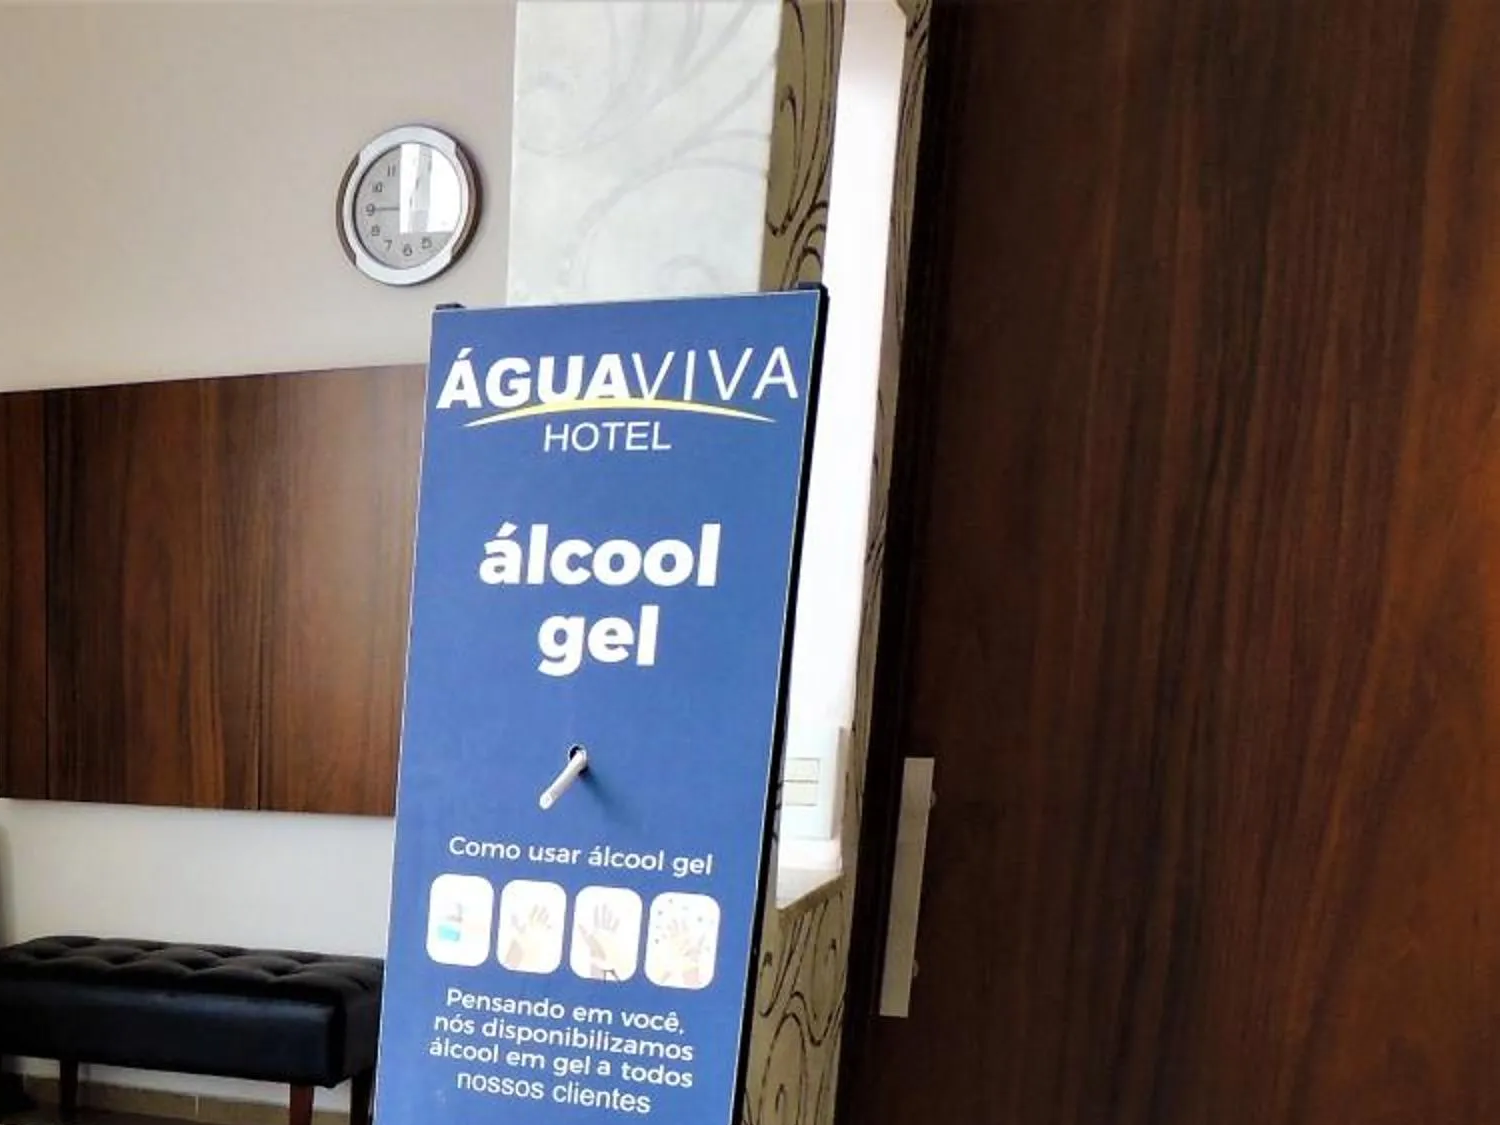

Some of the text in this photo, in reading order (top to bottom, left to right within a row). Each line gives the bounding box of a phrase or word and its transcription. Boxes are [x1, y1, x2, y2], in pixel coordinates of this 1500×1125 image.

[435, 346, 799, 410] ÁGUAVIVA
[543, 421, 672, 453] HOTEL
[479, 522, 721, 587] álcool
[536, 605, 660, 678] gel
[449, 835, 713, 878] Como usar álcool gel
[446, 987, 566, 1020] Pensando
[572, 1004, 613, 1025] em
[434, 1012, 694, 1062] nós disponibilizamos
[429, 1036, 694, 1089] álcool em gel a todos
[457, 1072, 652, 1114] nossos clientes
